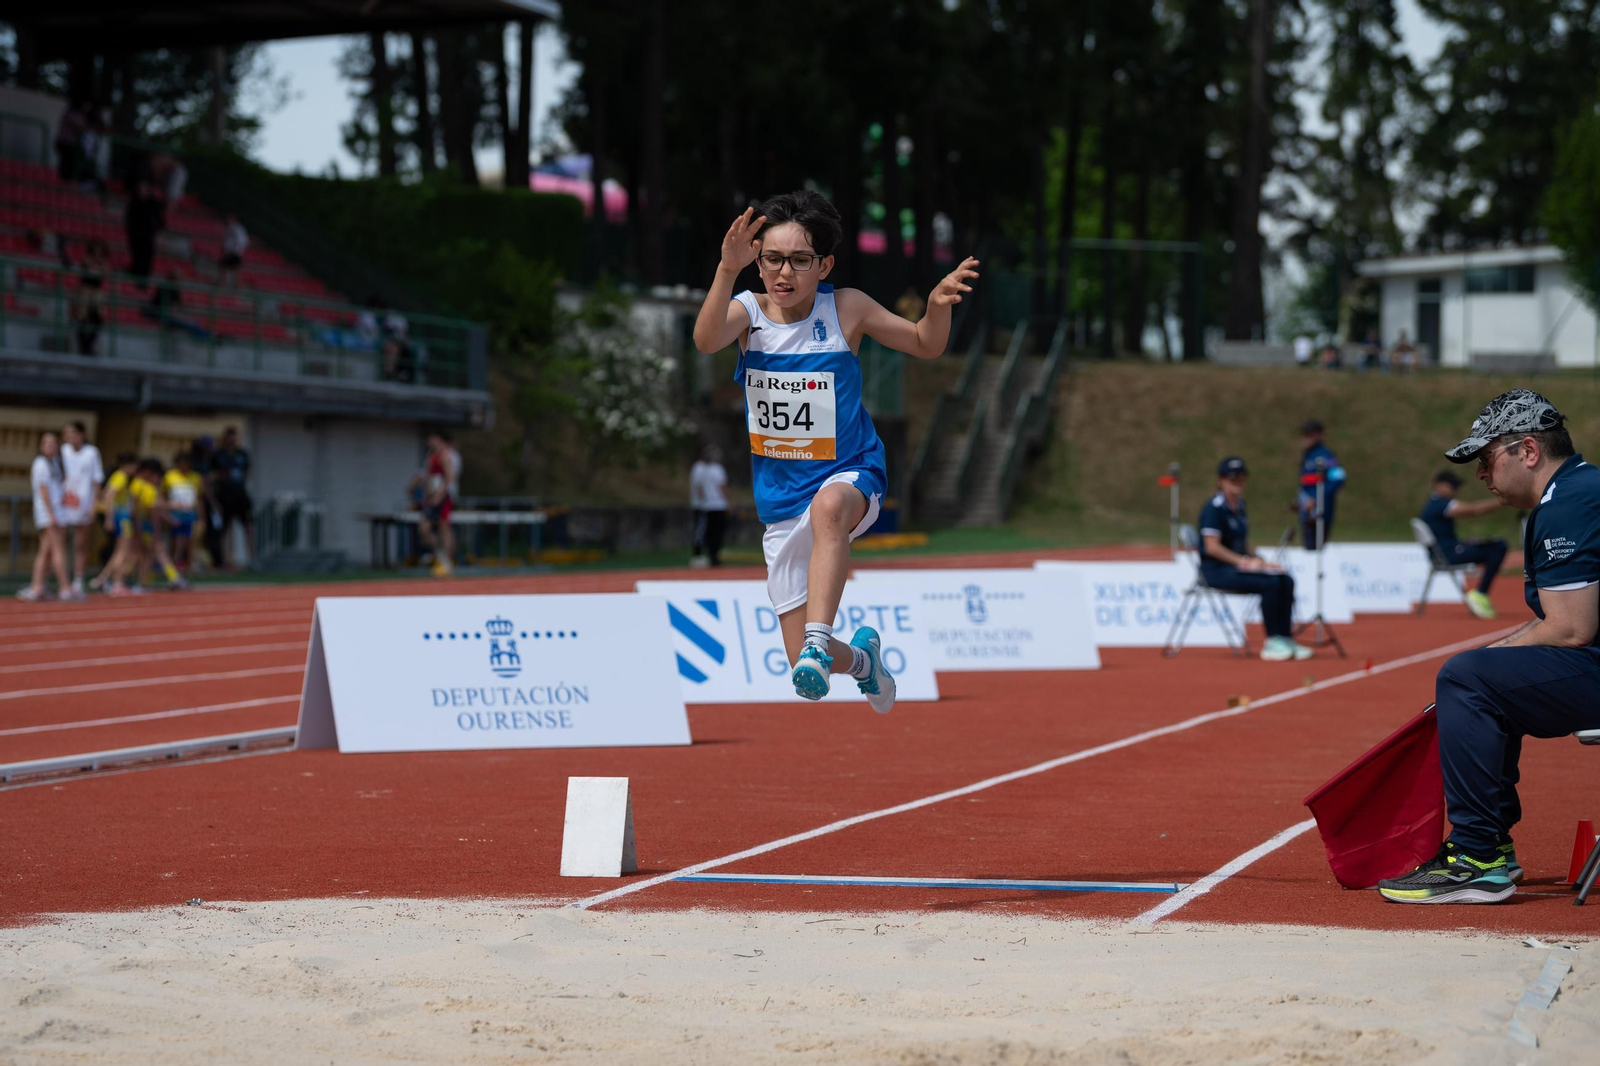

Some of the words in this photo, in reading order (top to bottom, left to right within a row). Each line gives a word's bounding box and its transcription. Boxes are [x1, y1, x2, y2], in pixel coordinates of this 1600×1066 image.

[747, 374, 764, 389] La
[767, 377, 828, 394] Región
[757, 400, 814, 431] 354
[763, 446, 814, 459] telemiño
[1093, 581, 1180, 602] XUNTA
[755, 604, 914, 634] DORTE
[1095, 604, 1127, 628] DE
[431, 681, 590, 707] DEPUTACIÓN
[457, 710, 573, 731] OURENSE
